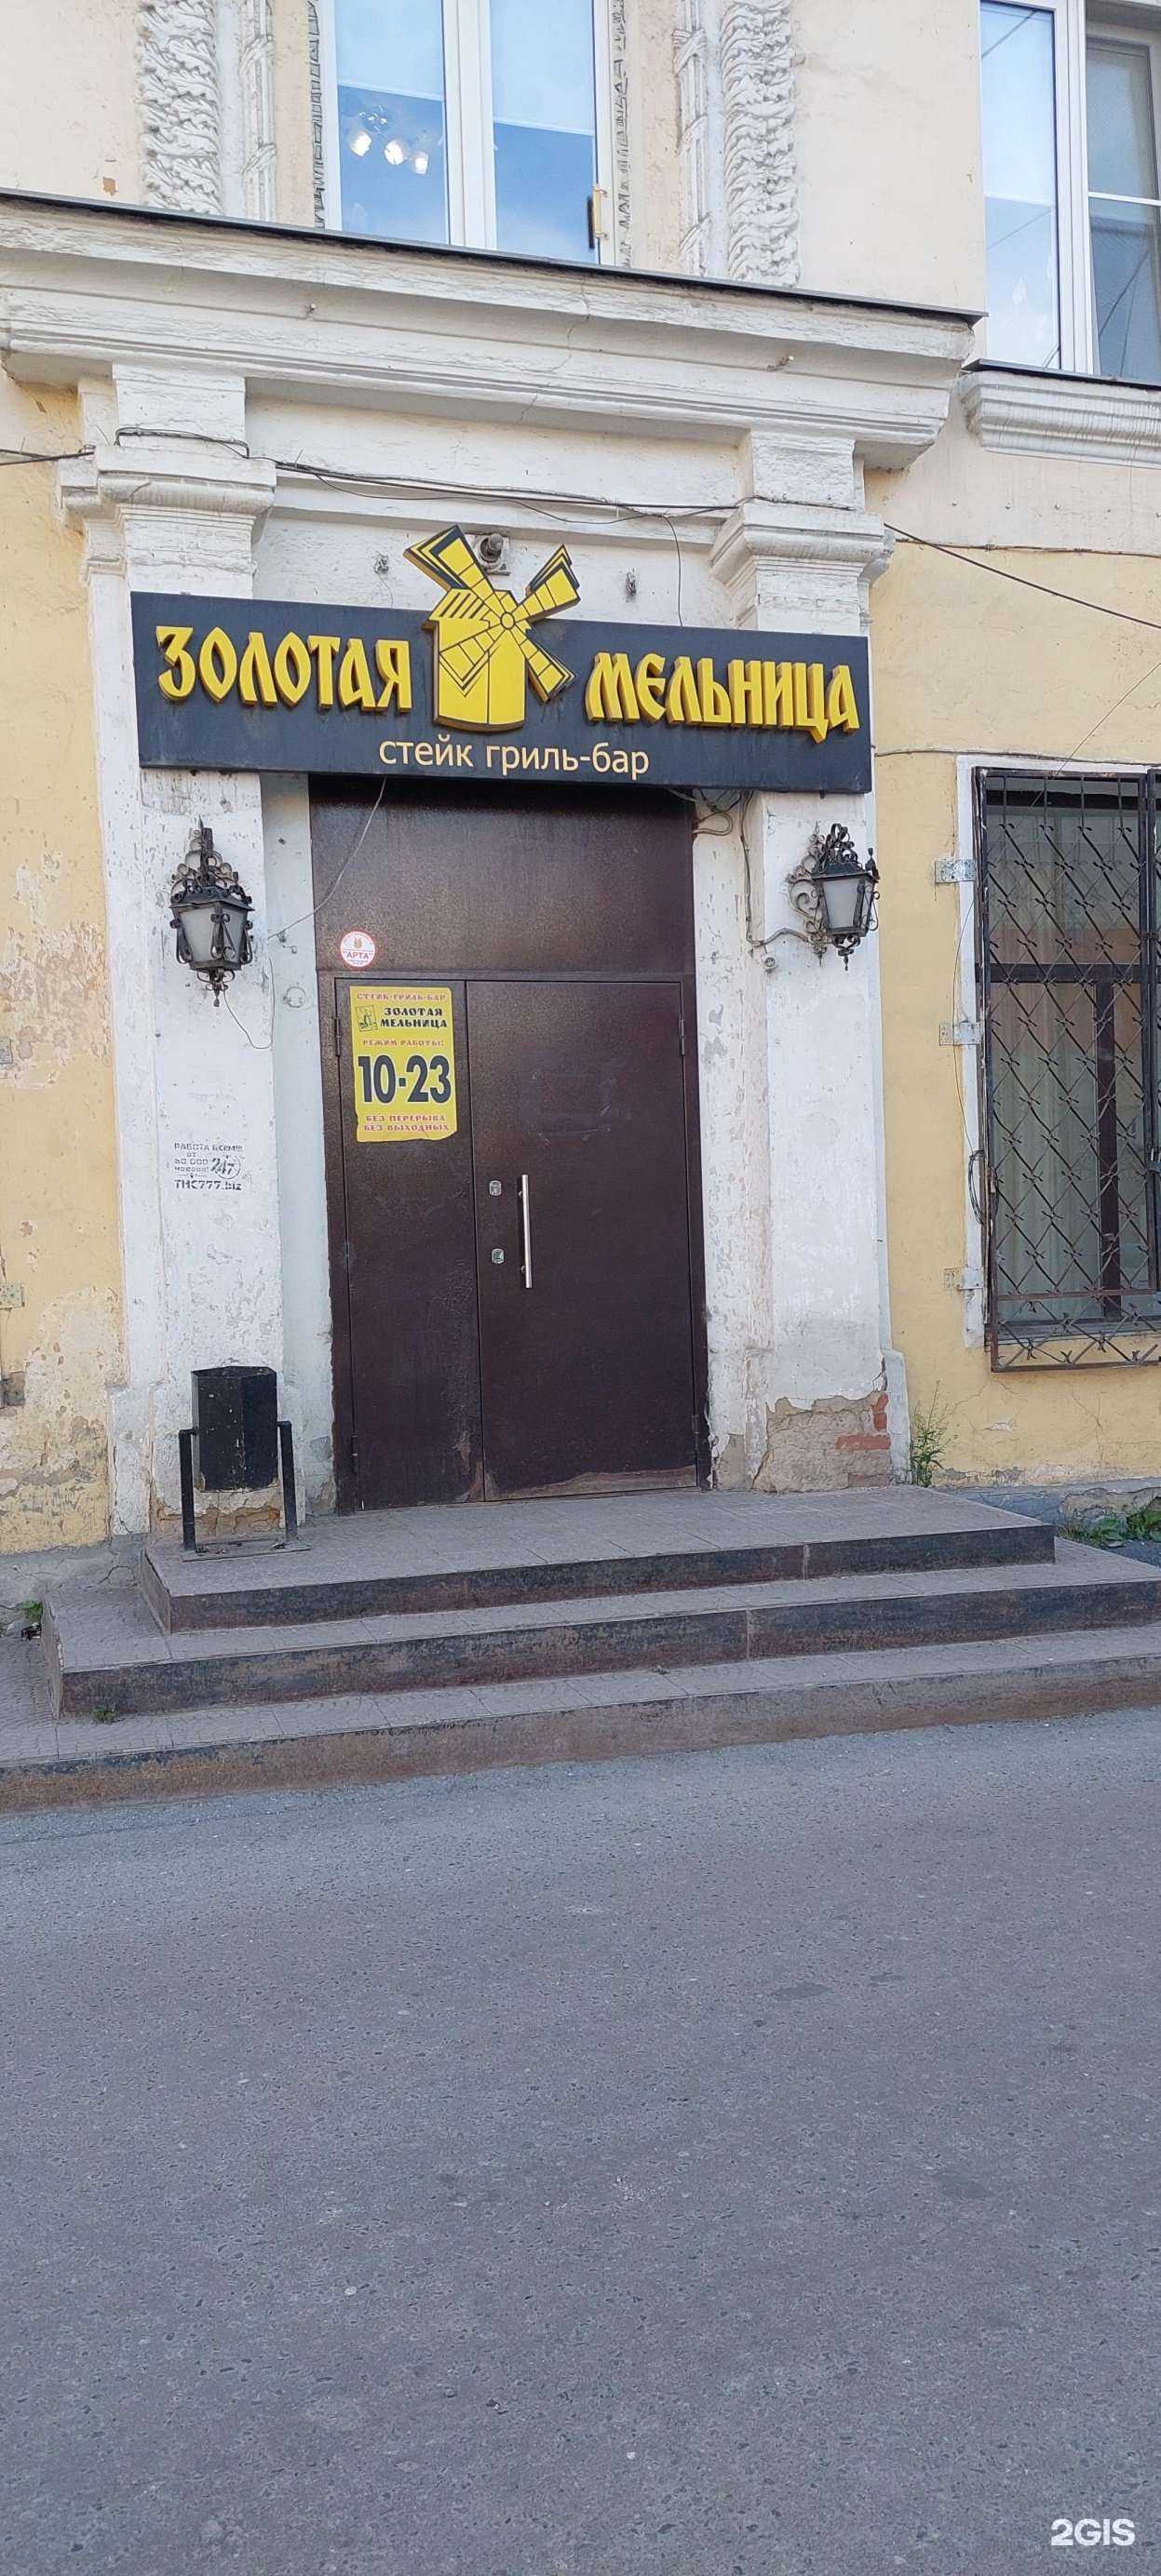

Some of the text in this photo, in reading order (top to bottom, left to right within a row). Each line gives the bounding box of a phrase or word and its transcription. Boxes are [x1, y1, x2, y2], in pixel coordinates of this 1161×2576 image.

[155, 625, 860, 744] ЗОЛОТАЯ МЕЛЬНИЦА
[379, 735, 649, 780] стейк гриль-бар
[380, 1018, 448, 1029] МЕЛЬНИЦА
[384, 1007, 443, 1016] ЗОЛОТАЯ
